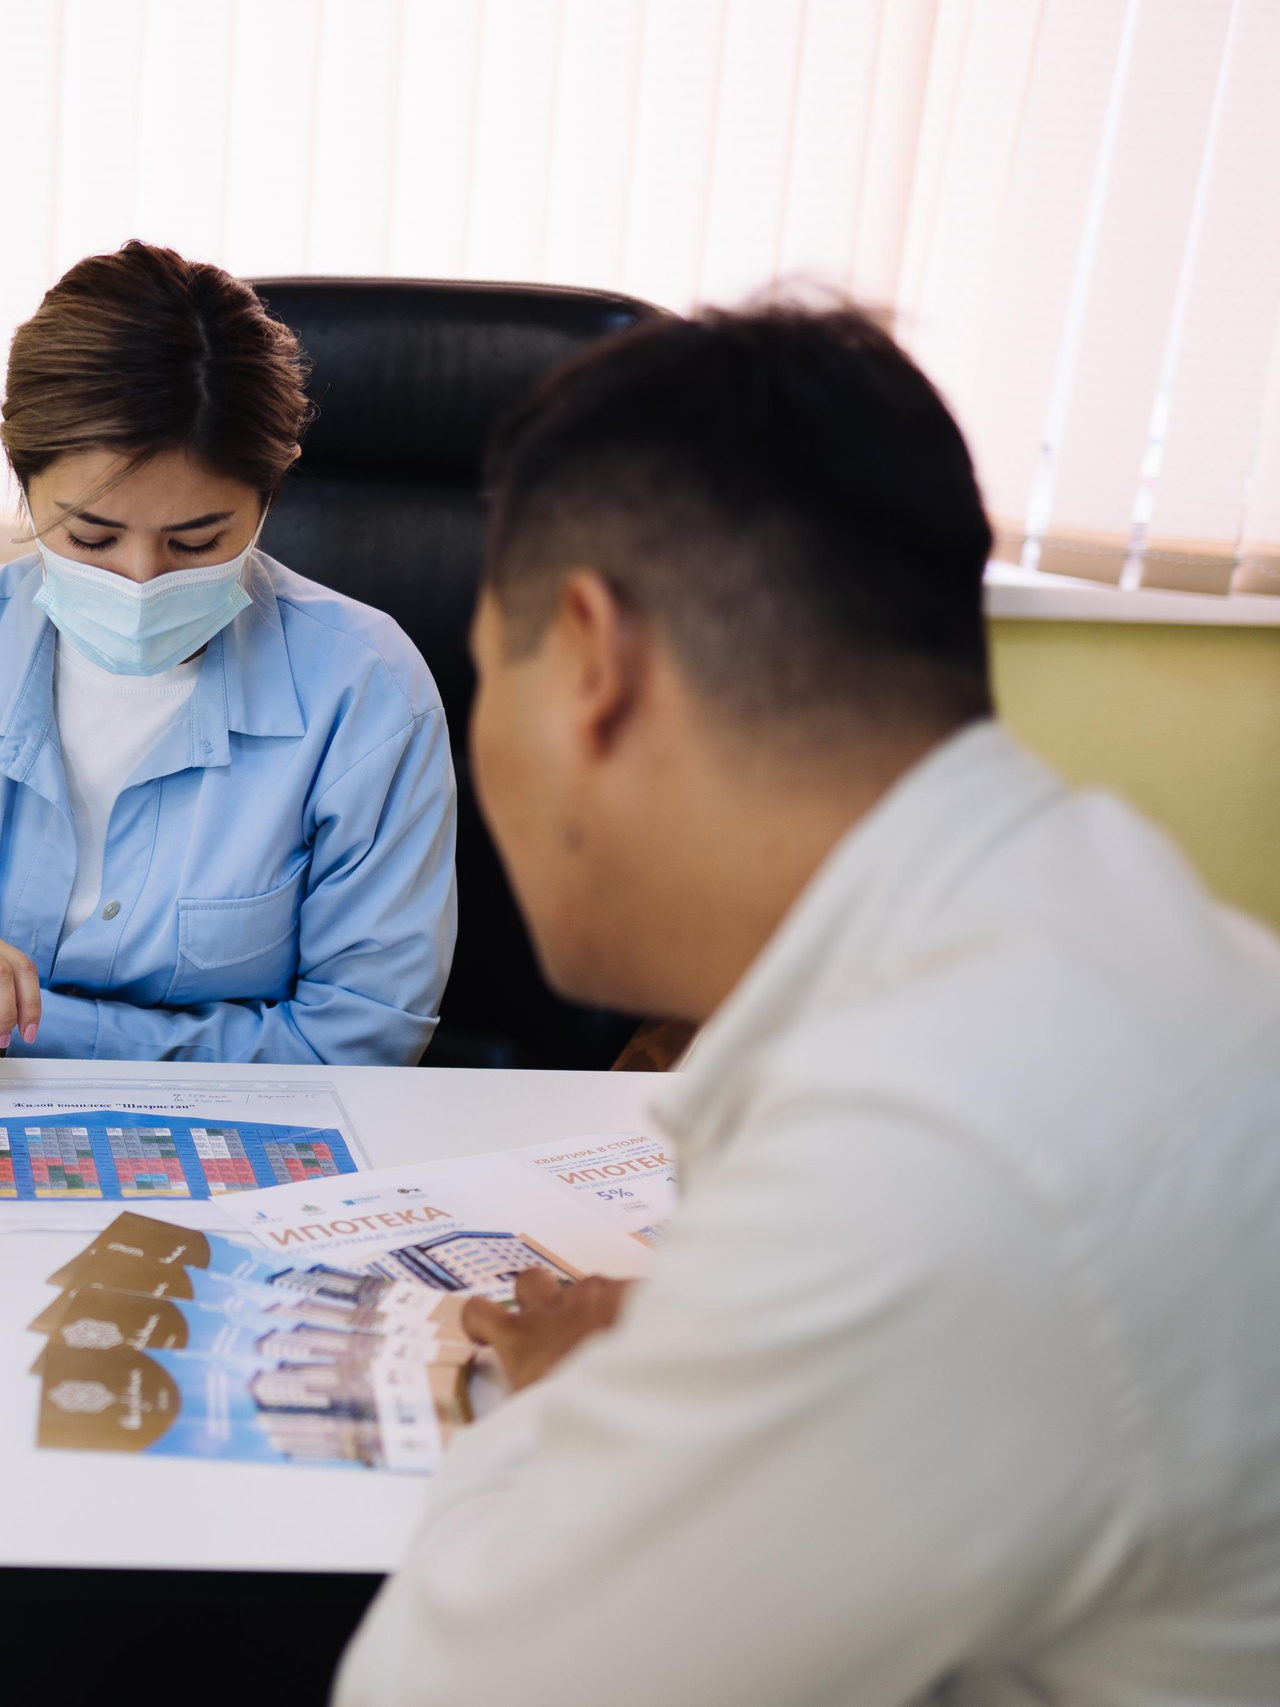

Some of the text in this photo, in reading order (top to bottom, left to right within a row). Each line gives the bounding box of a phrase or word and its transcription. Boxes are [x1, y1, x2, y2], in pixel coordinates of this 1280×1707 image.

[533, 1149, 595, 1165] КВАРТИРА
[596, 1188, 634, 1201] 5%
[268, 1205, 453, 1247] ИПОТЕКА
